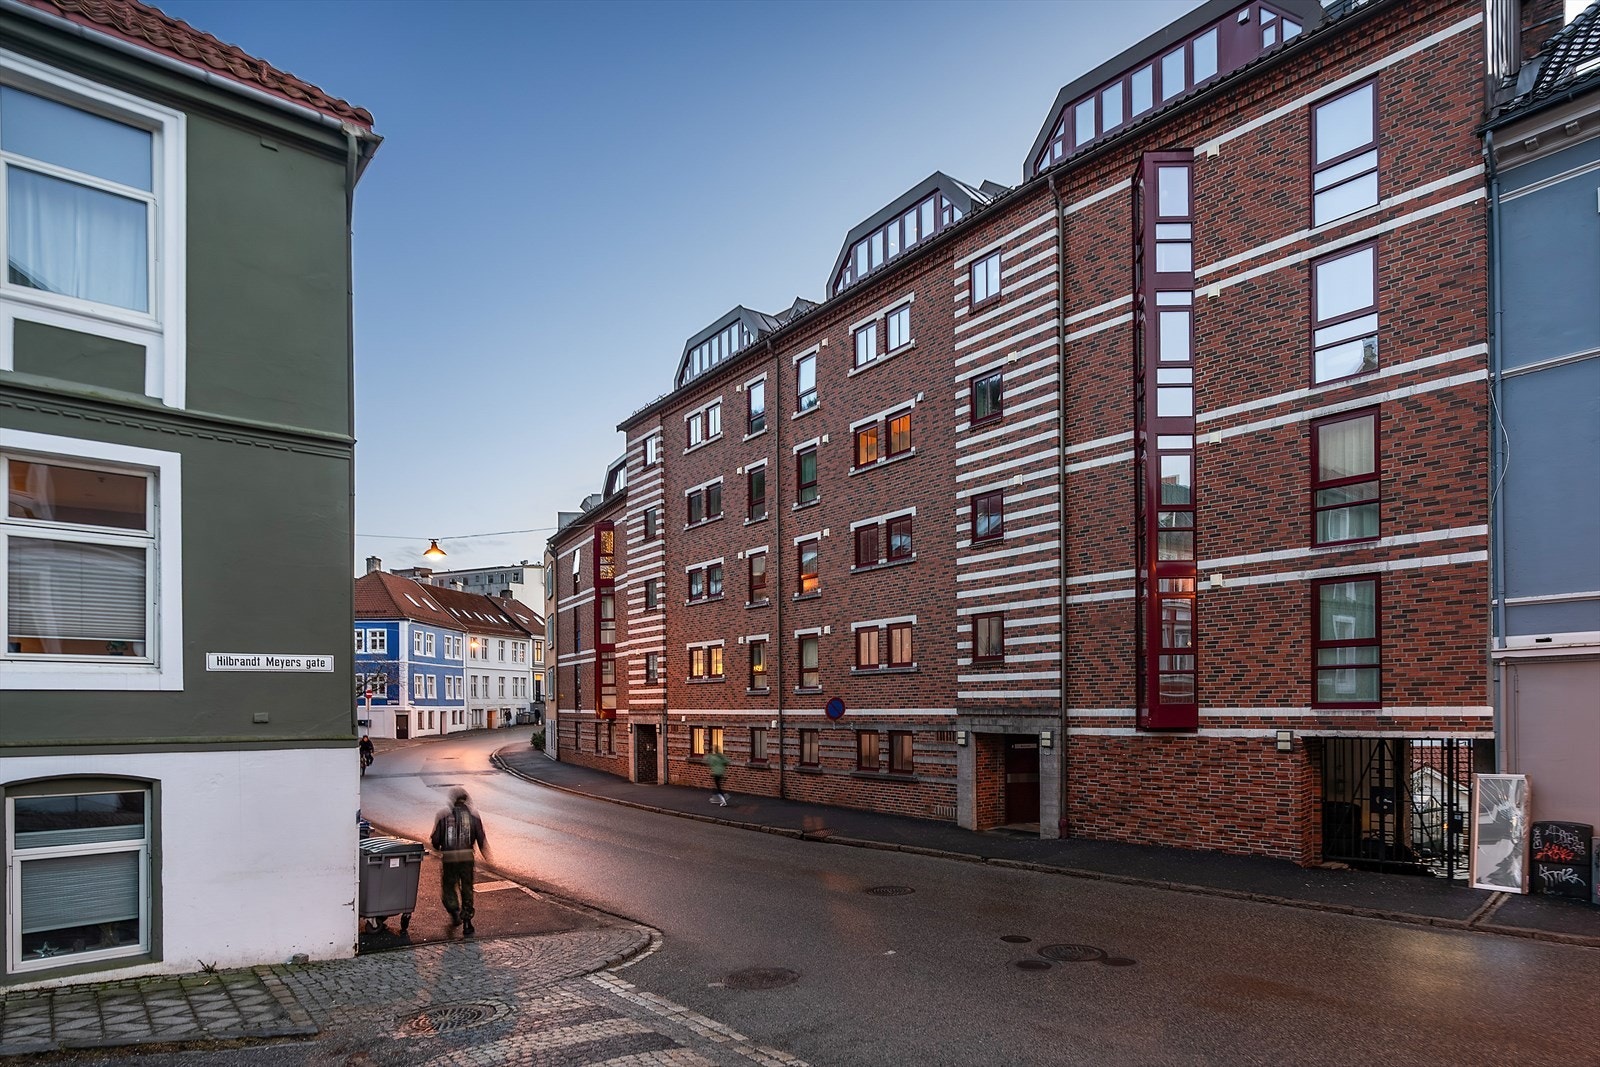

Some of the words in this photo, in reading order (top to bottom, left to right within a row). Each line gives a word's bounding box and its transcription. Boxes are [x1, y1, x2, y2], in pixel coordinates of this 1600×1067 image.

[216, 655, 261, 667] Hilbrandt
[266, 656, 301, 669] Meyers
[306, 657, 326, 670] gate
